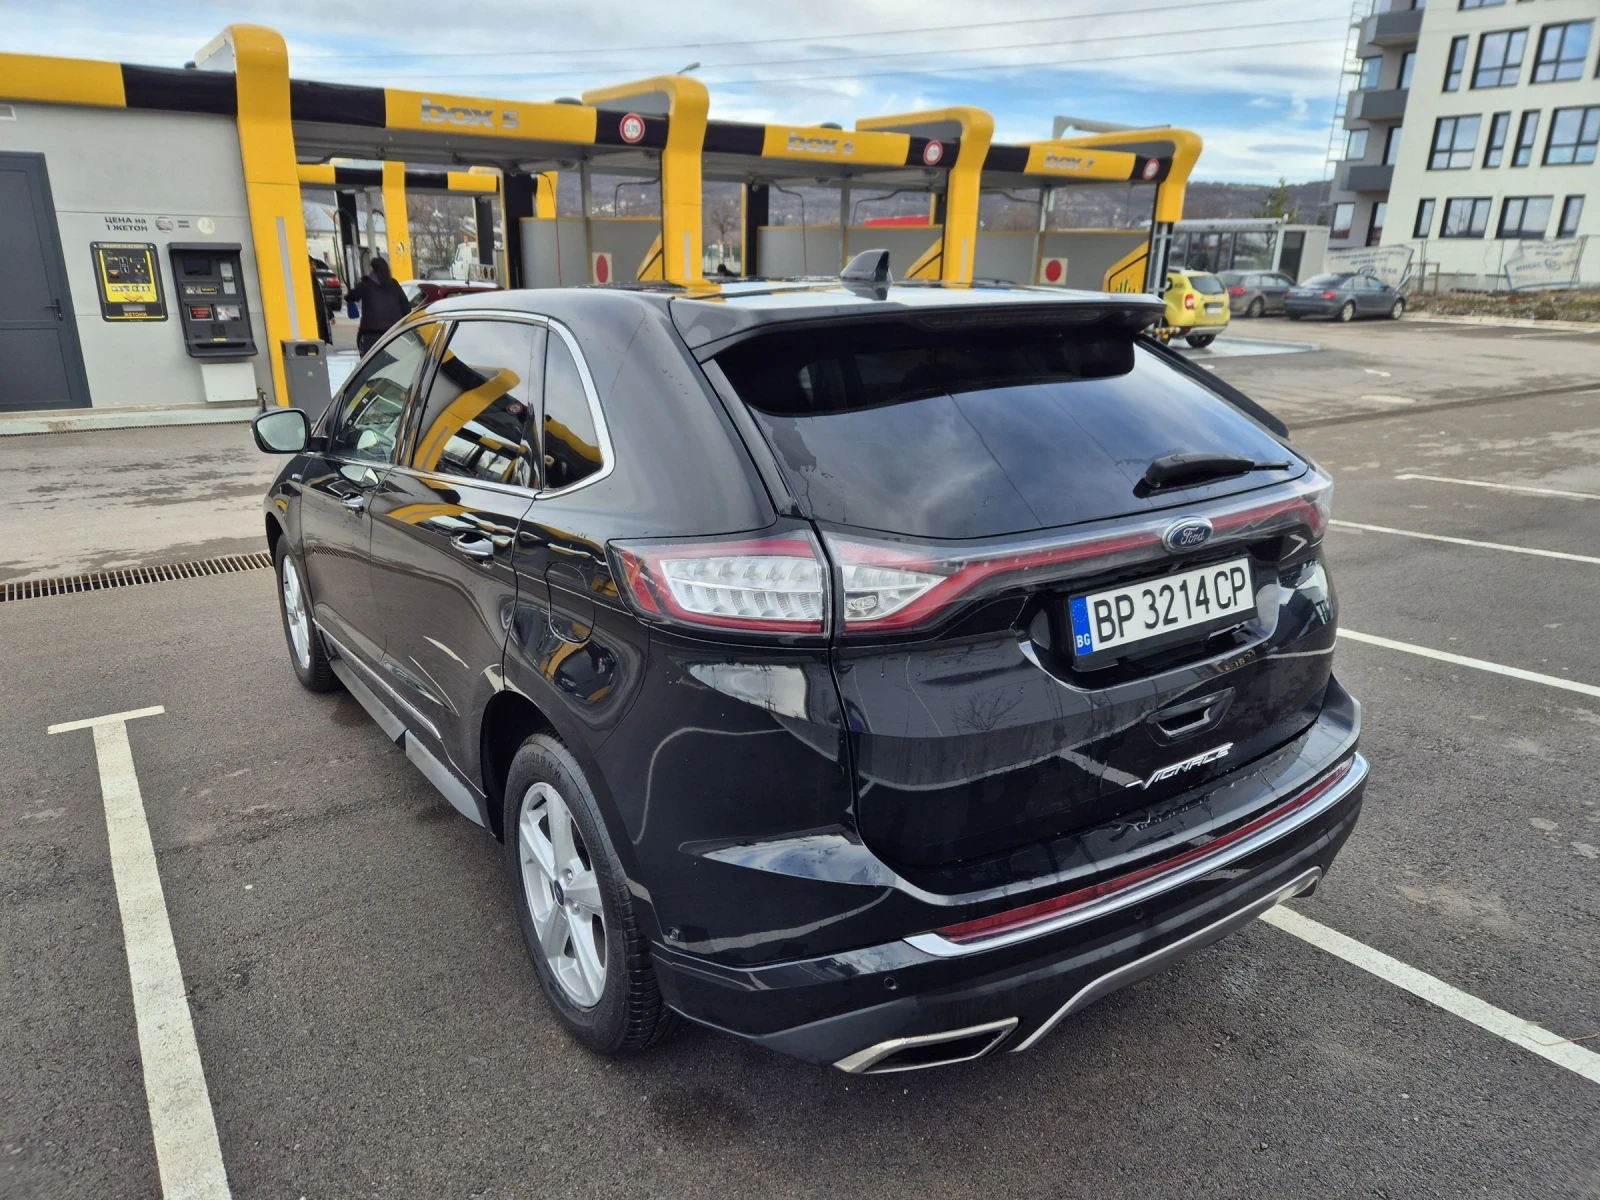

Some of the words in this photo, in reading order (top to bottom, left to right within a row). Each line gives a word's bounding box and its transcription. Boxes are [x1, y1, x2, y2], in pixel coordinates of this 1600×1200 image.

[421, 98, 494, 128] box
[502, 110, 520, 130] 5
[625, 124, 640, 133] 2.75
[787, 131, 839, 155] box
[842, 140, 856, 156] 6
[1044, 151, 1082, 170] box
[104, 216, 132, 224] ЦЕНА
[1180, 526, 1206, 545] Ford
[1094, 594, 1135, 643] BP
[1076, 633, 1091, 648] BG
